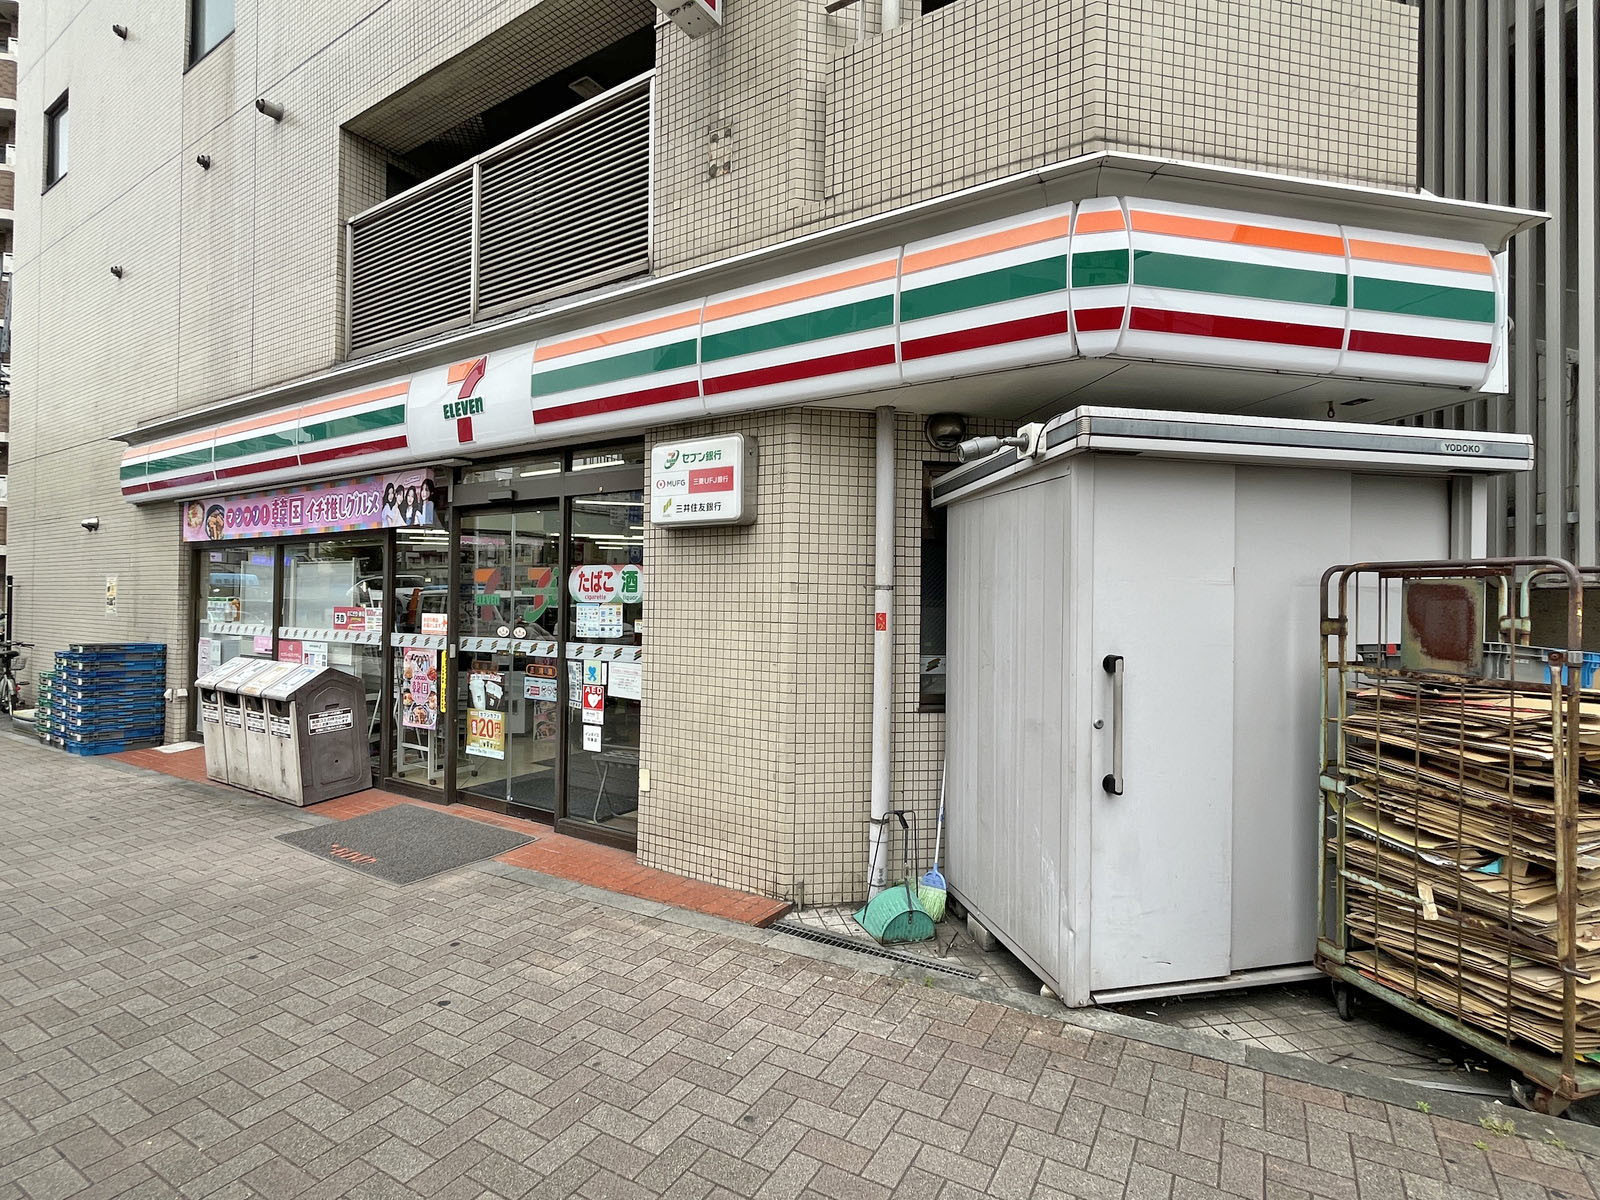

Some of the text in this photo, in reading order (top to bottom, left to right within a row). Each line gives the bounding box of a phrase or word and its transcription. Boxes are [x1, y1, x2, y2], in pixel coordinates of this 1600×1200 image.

[1444, 443, 1481, 453] YODOKO
[682, 450, 722, 464] セブン銀行
[666, 479, 686, 488] MUFG
[676, 501, 722, 514] 三井住友銀行
[578, 570, 614, 593] たばこ
[621, 570, 639, 593] 酒
[584, 686, 603, 694] AED
